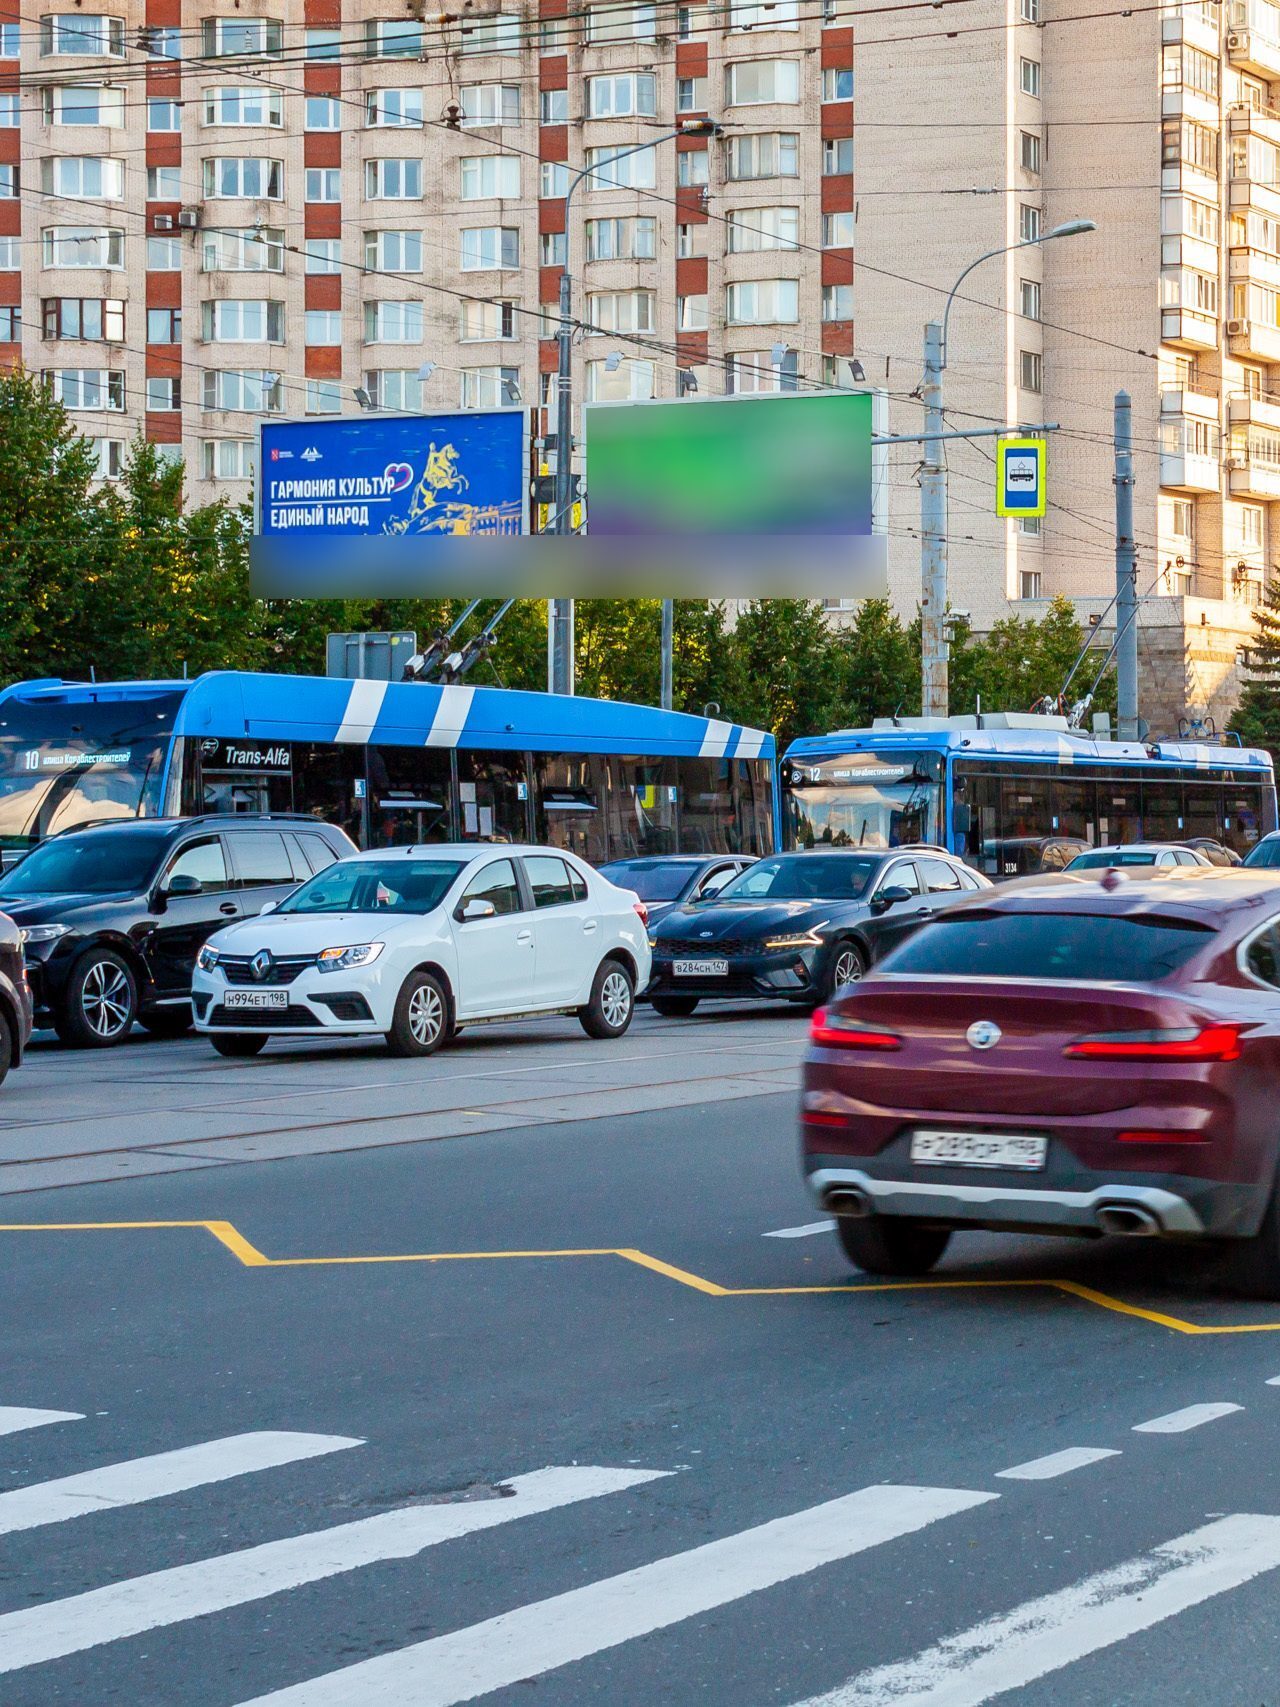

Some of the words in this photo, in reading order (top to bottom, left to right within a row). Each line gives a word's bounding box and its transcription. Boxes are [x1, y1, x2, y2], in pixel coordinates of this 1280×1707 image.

[271, 479, 336, 499] ГАРМОНИЯ
[339, 476, 395, 496] КУЛЬТУР
[270, 504, 324, 529] ЕДИНЫЙ
[327, 505, 369, 527] НАРОД
[25, 751, 39, 770] 10
[225, 746, 290, 765] Trans-Alfa
[810, 768, 820, 782] 12
[1005, 863, 1017, 873] 3134
[677, 962, 711, 973] В284СН
[712, 961, 725, 970] 147
[228, 993, 267, 1006] Н994ЕТ
[270, 993, 285, 1002] 198
